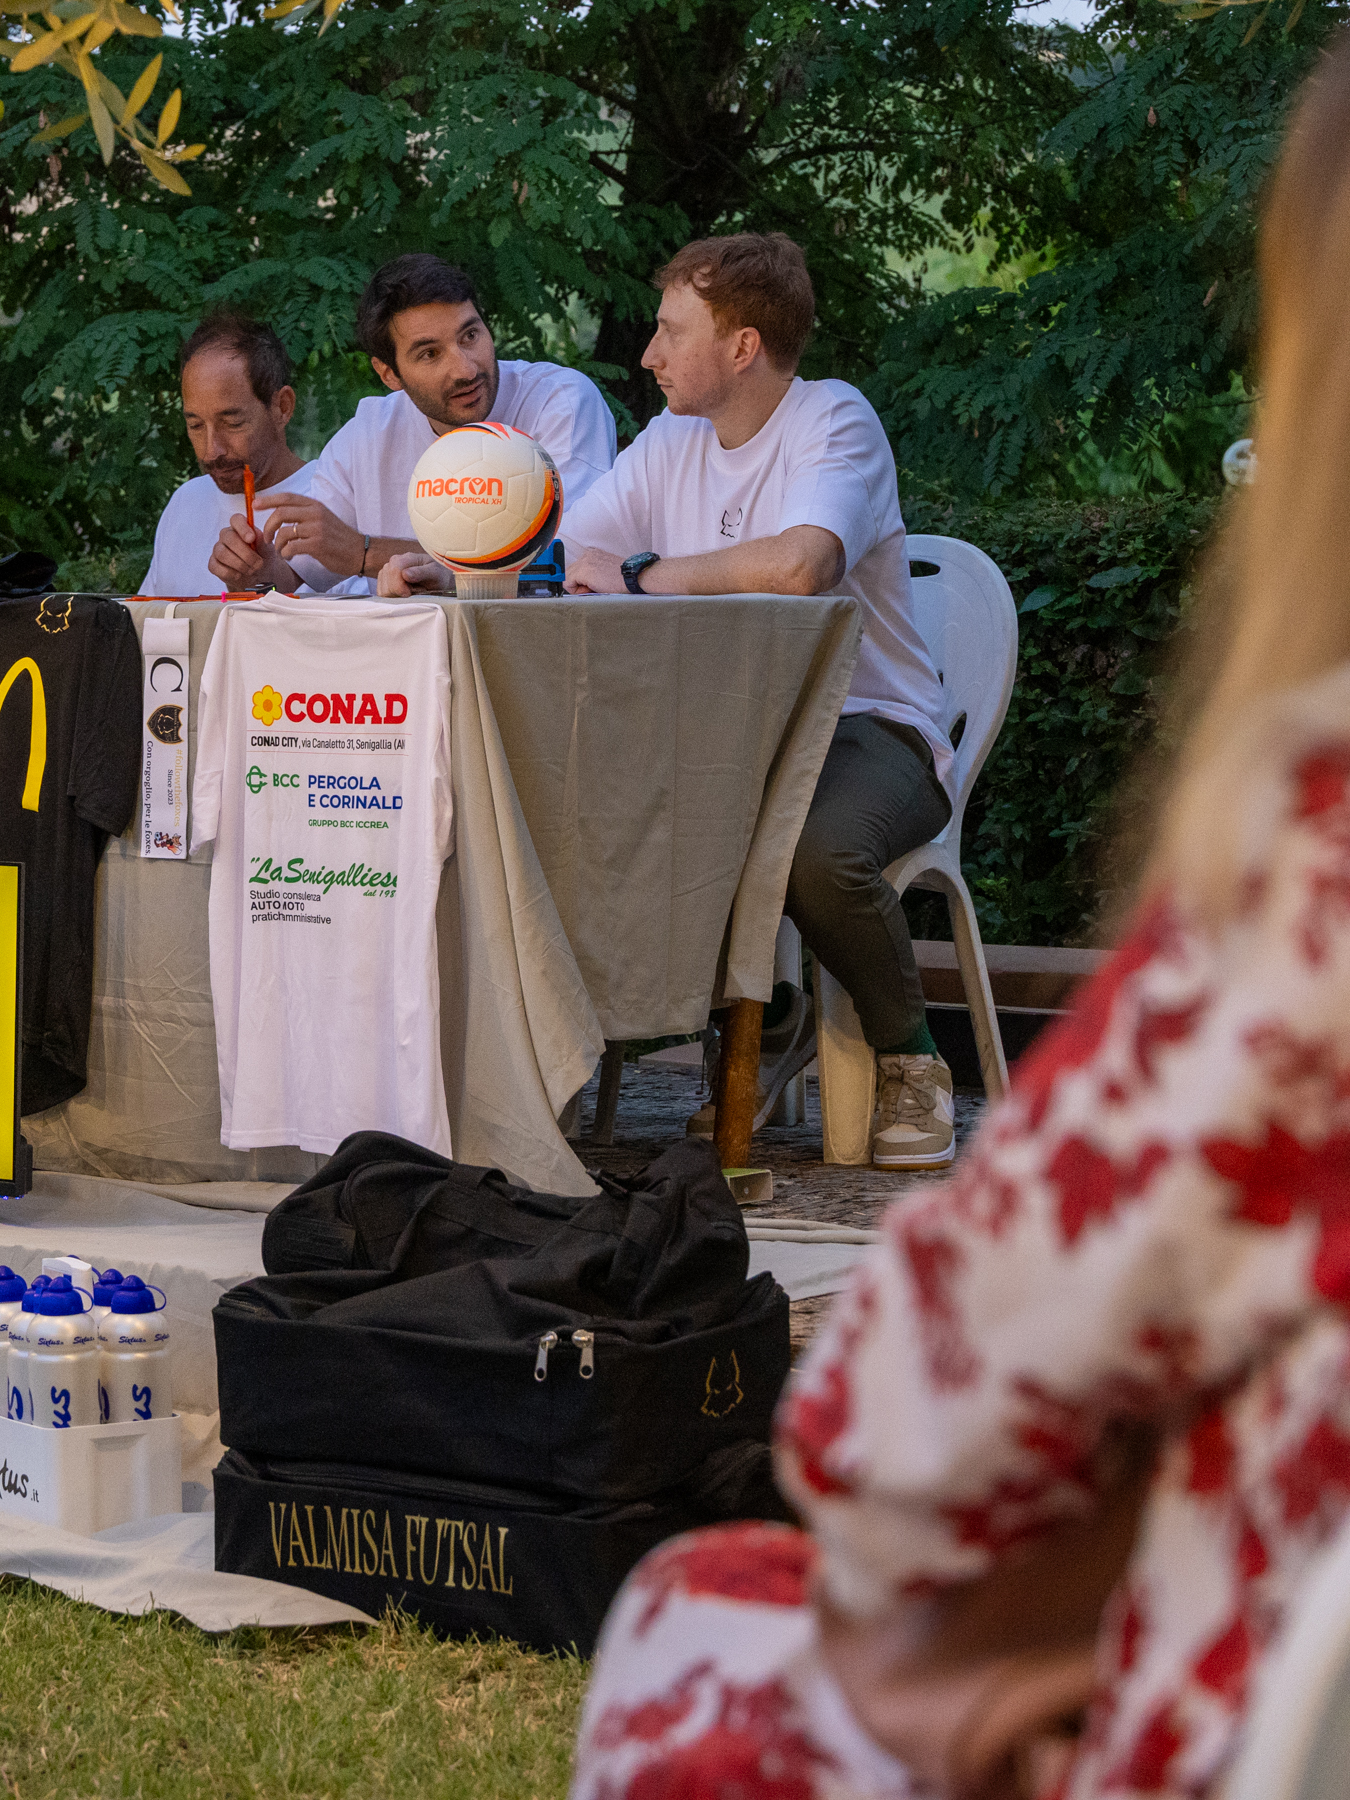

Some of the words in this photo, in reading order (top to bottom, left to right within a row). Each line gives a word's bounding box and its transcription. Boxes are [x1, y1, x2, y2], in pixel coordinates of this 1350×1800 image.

[416, 477, 503, 499] macron
[454, 496, 489, 505] TROPICAL
[491, 498, 503, 506] XH
[284, 692, 408, 725] CONAD
[146, 740, 154, 759] Con
[250, 735, 280, 747] CONAD
[281, 736, 301, 749] CITY,
[301, 739, 311, 748] via
[312, 738, 346, 749] Canaletto
[355, 739, 392, 751] Senigallia
[144, 760, 153, 802] orgoglio,
[174, 748, 184, 828] #followthefoxes
[272, 773, 300, 788] BCC
[308, 774, 382, 790] PERGOLA
[308, 793, 316, 808] E
[144, 803, 152, 817] per
[144, 818, 153, 829] le
[308, 818, 339, 828] GRUPPO
[339, 820, 354, 828] BCC
[355, 820, 389, 829] ICCREA
[144, 829, 153, 856] foxes.
[249, 889, 281, 900] Studio
[363, 889, 377, 897] dal
[250, 901, 281, 911] AUTO
[268, 1501, 399, 1578] VALMISA
[405, 1513, 513, 1596] FUTSAL
